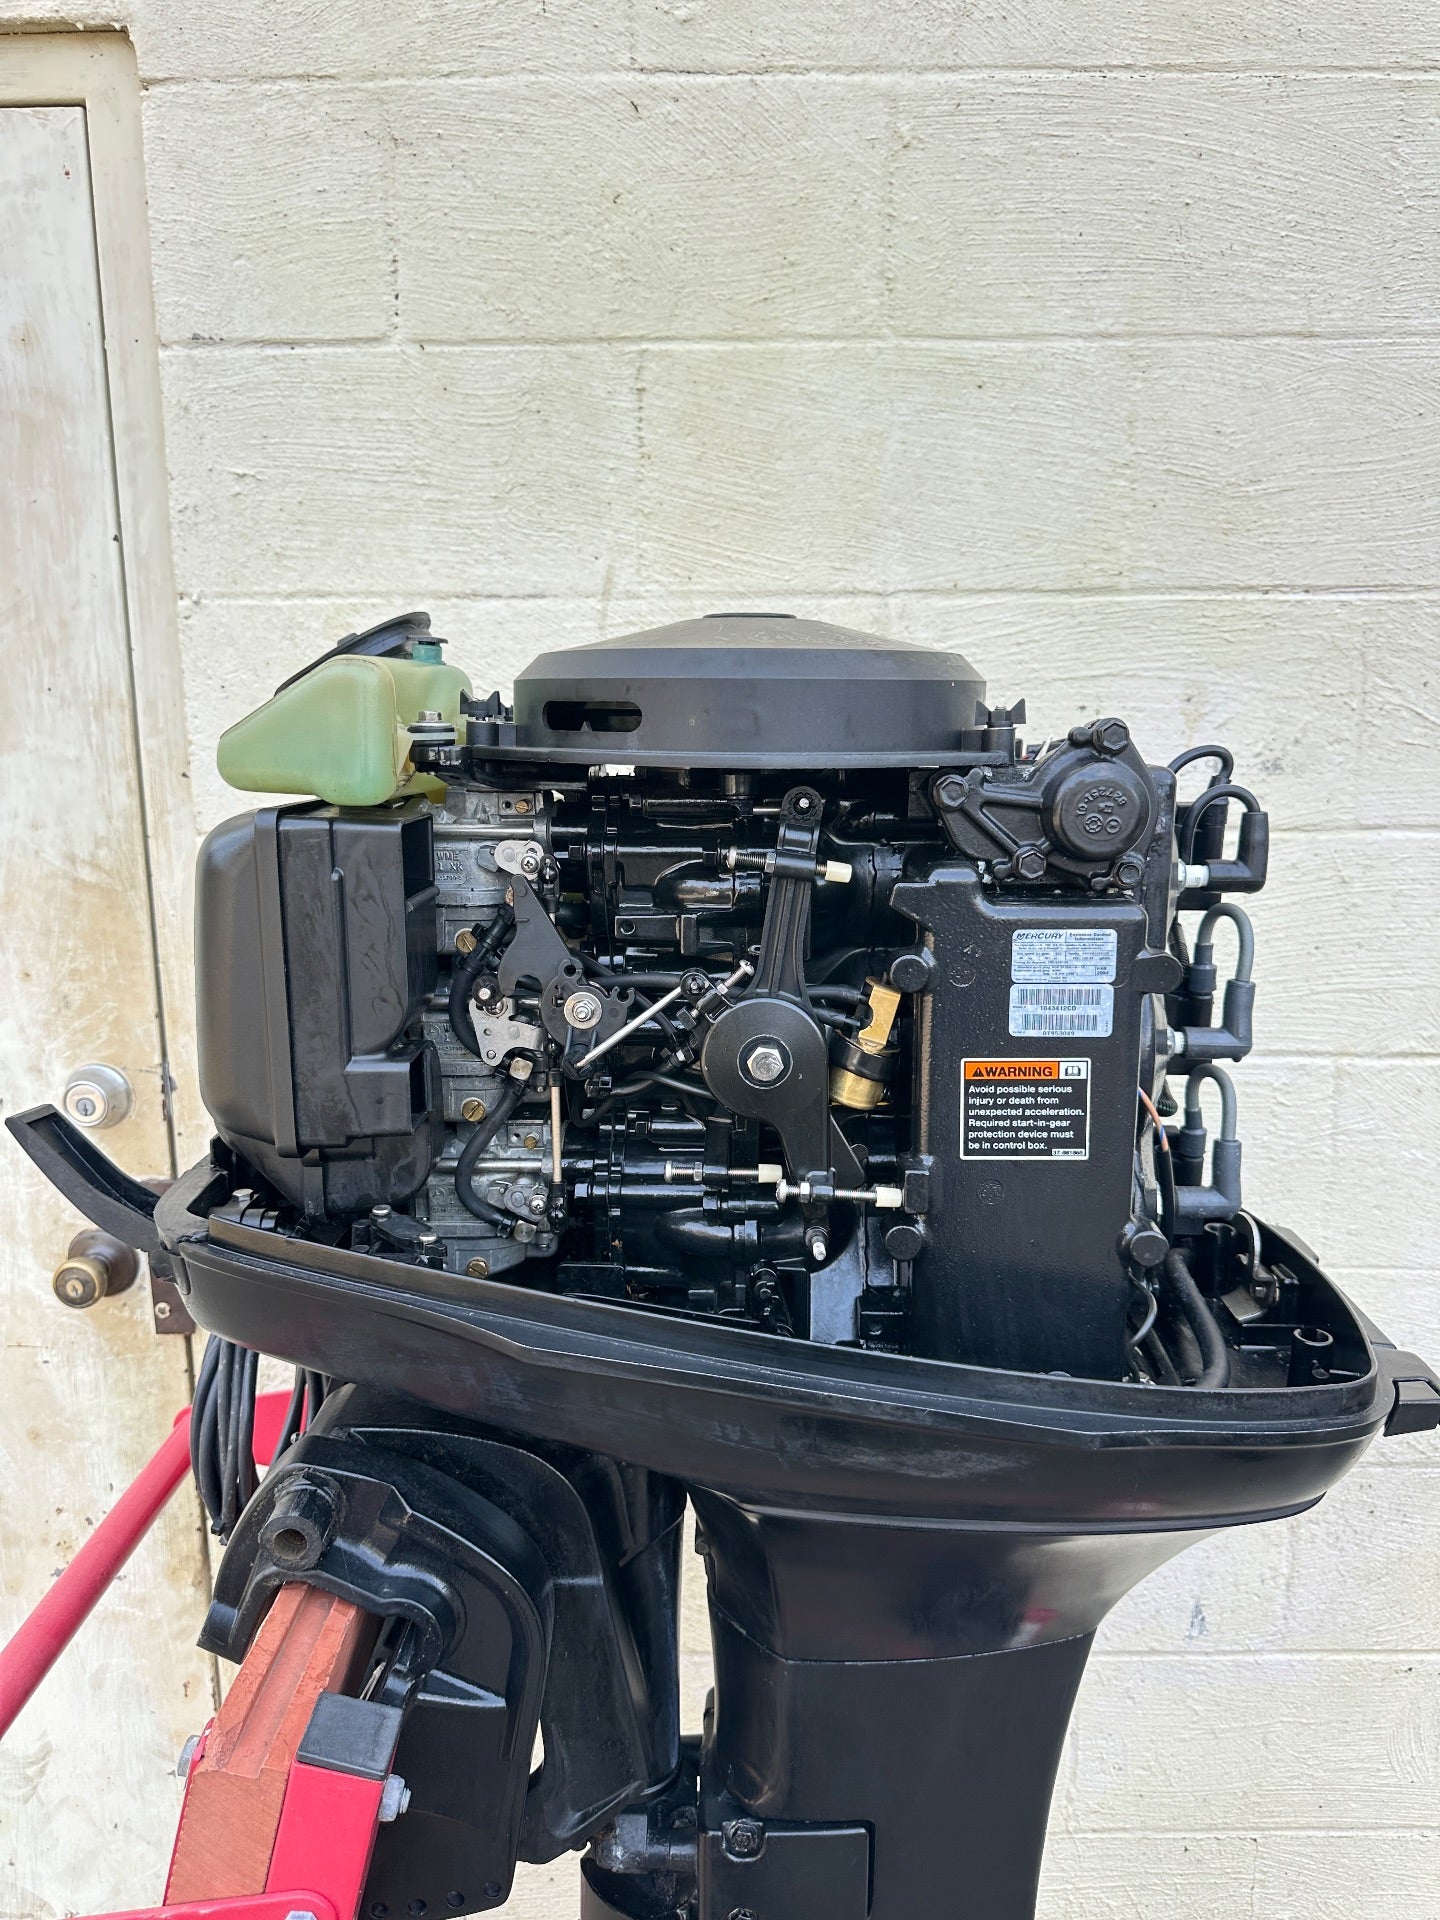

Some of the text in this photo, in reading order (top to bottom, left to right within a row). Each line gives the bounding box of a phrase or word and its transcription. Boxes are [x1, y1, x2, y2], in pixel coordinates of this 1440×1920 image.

[1016, 932, 1064, 940] MERCURY
[985, 1066, 1052, 1077] WARNING
[968, 1085, 1072, 1094] Avoid possible serious
[968, 1096, 994, 1106] injury
[1008, 1096, 1035, 1104] death
[1037, 1096, 1059, 1104] from
[968, 1108, 1084, 1118] unexpected acceleration.
[968, 1119, 1071, 1128] Required start-in-gear
[968, 1130, 1016, 1139] protection
[1018, 1130, 1048, 1138] device
[968, 1141, 1047, 1149] be in control box.
